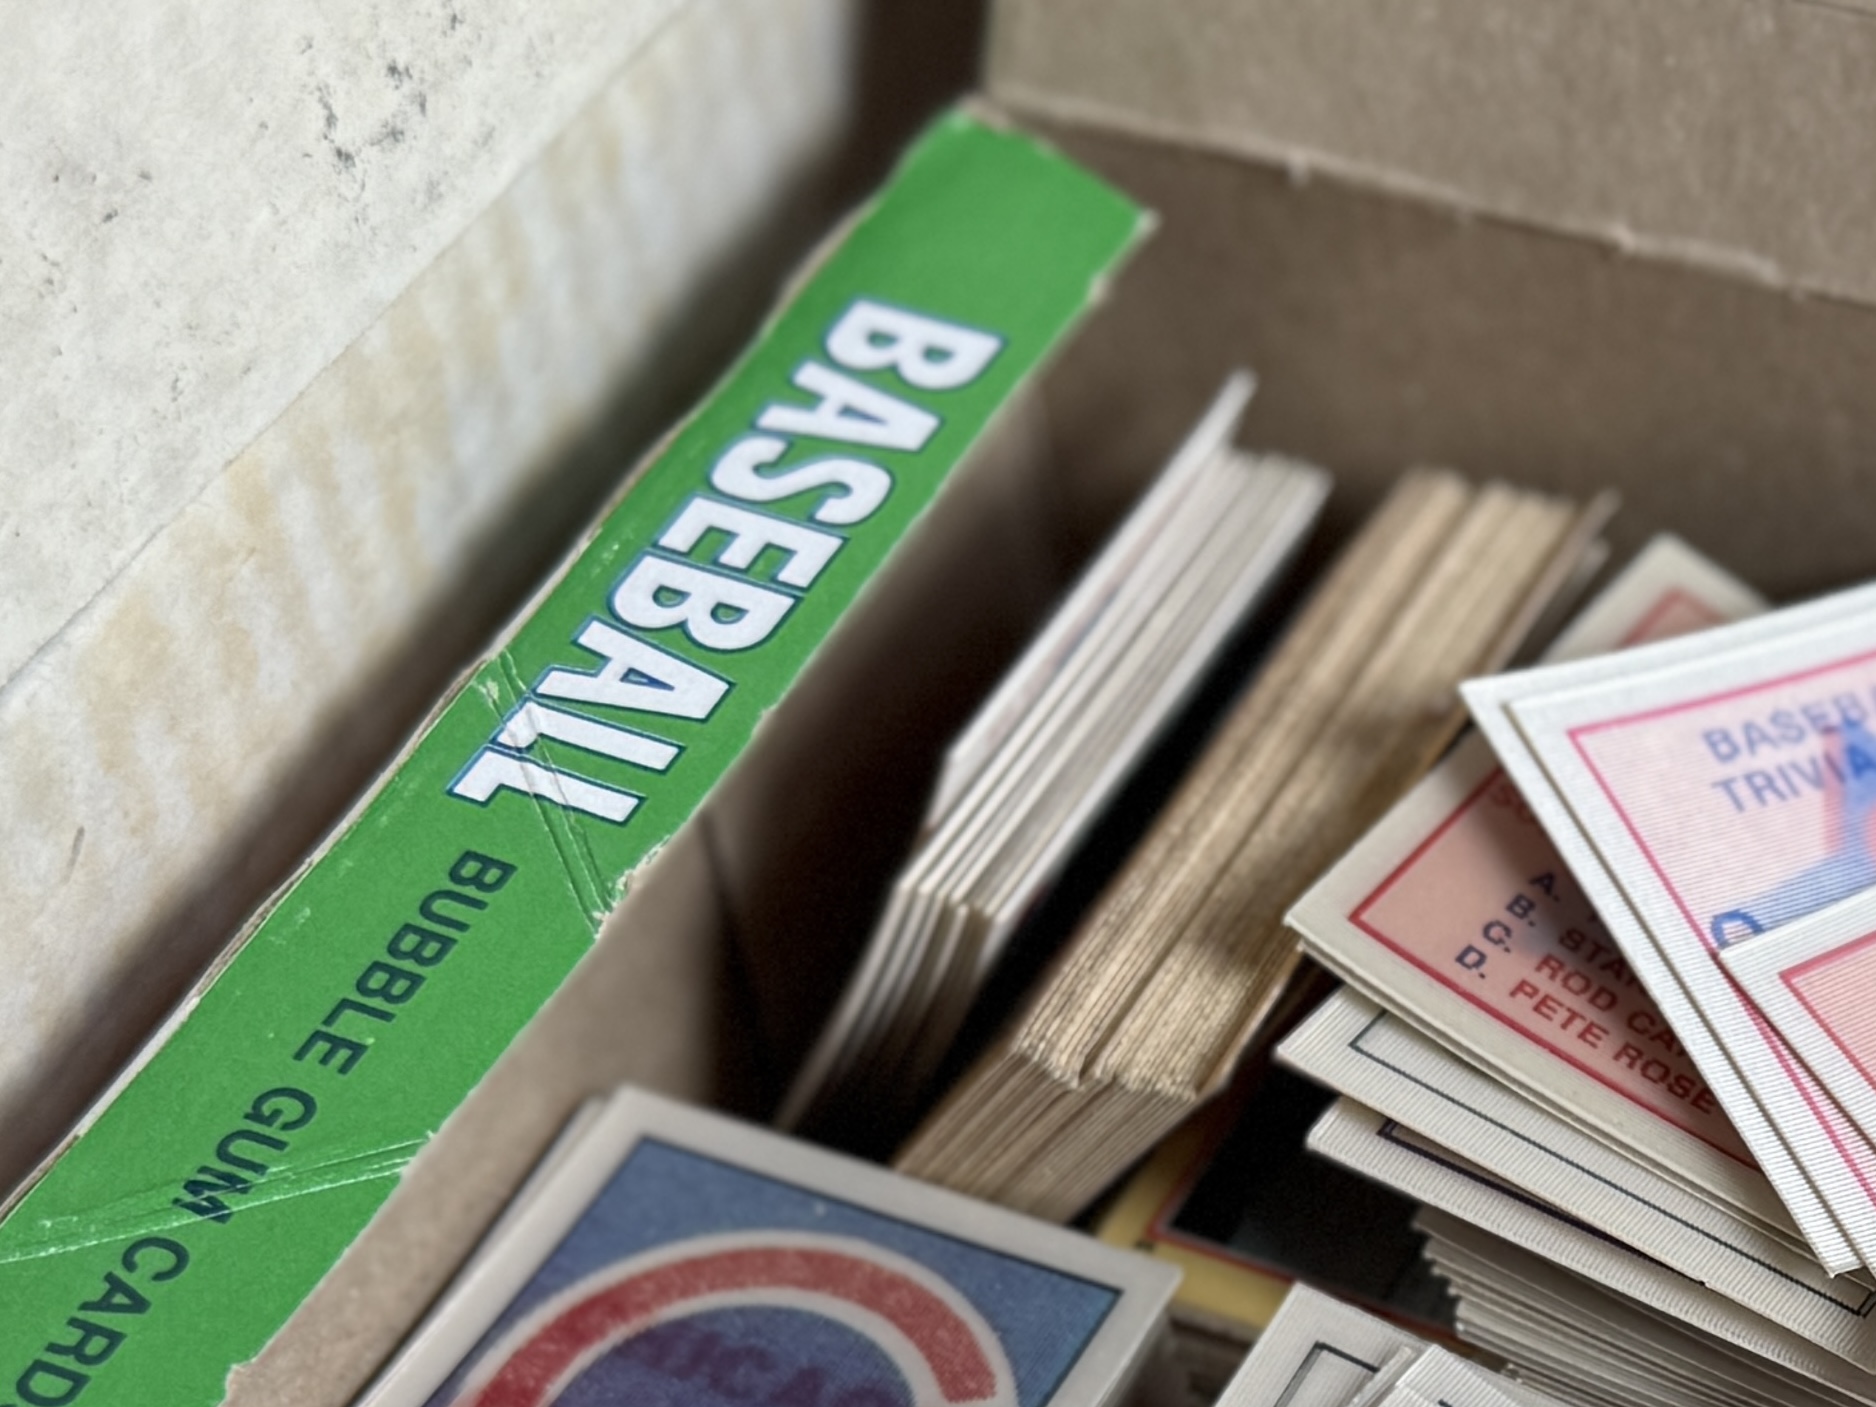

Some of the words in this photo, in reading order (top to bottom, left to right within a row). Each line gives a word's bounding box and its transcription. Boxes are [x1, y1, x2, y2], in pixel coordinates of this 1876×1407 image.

[448, 297, 1004, 827] BASEBALL
[293, 850, 518, 1075] BUBBLE
[1455, 944, 1487, 980] D.
[1508, 978, 1611, 1050] PETE
[1612, 1041, 1718, 1116] ROSE
[1534, 952, 1619, 1014] ROD
[1626, 1007, 1684, 1054] CA
[1557, 927, 1641, 988] STA
[171, 1086, 316, 1226] GUM
